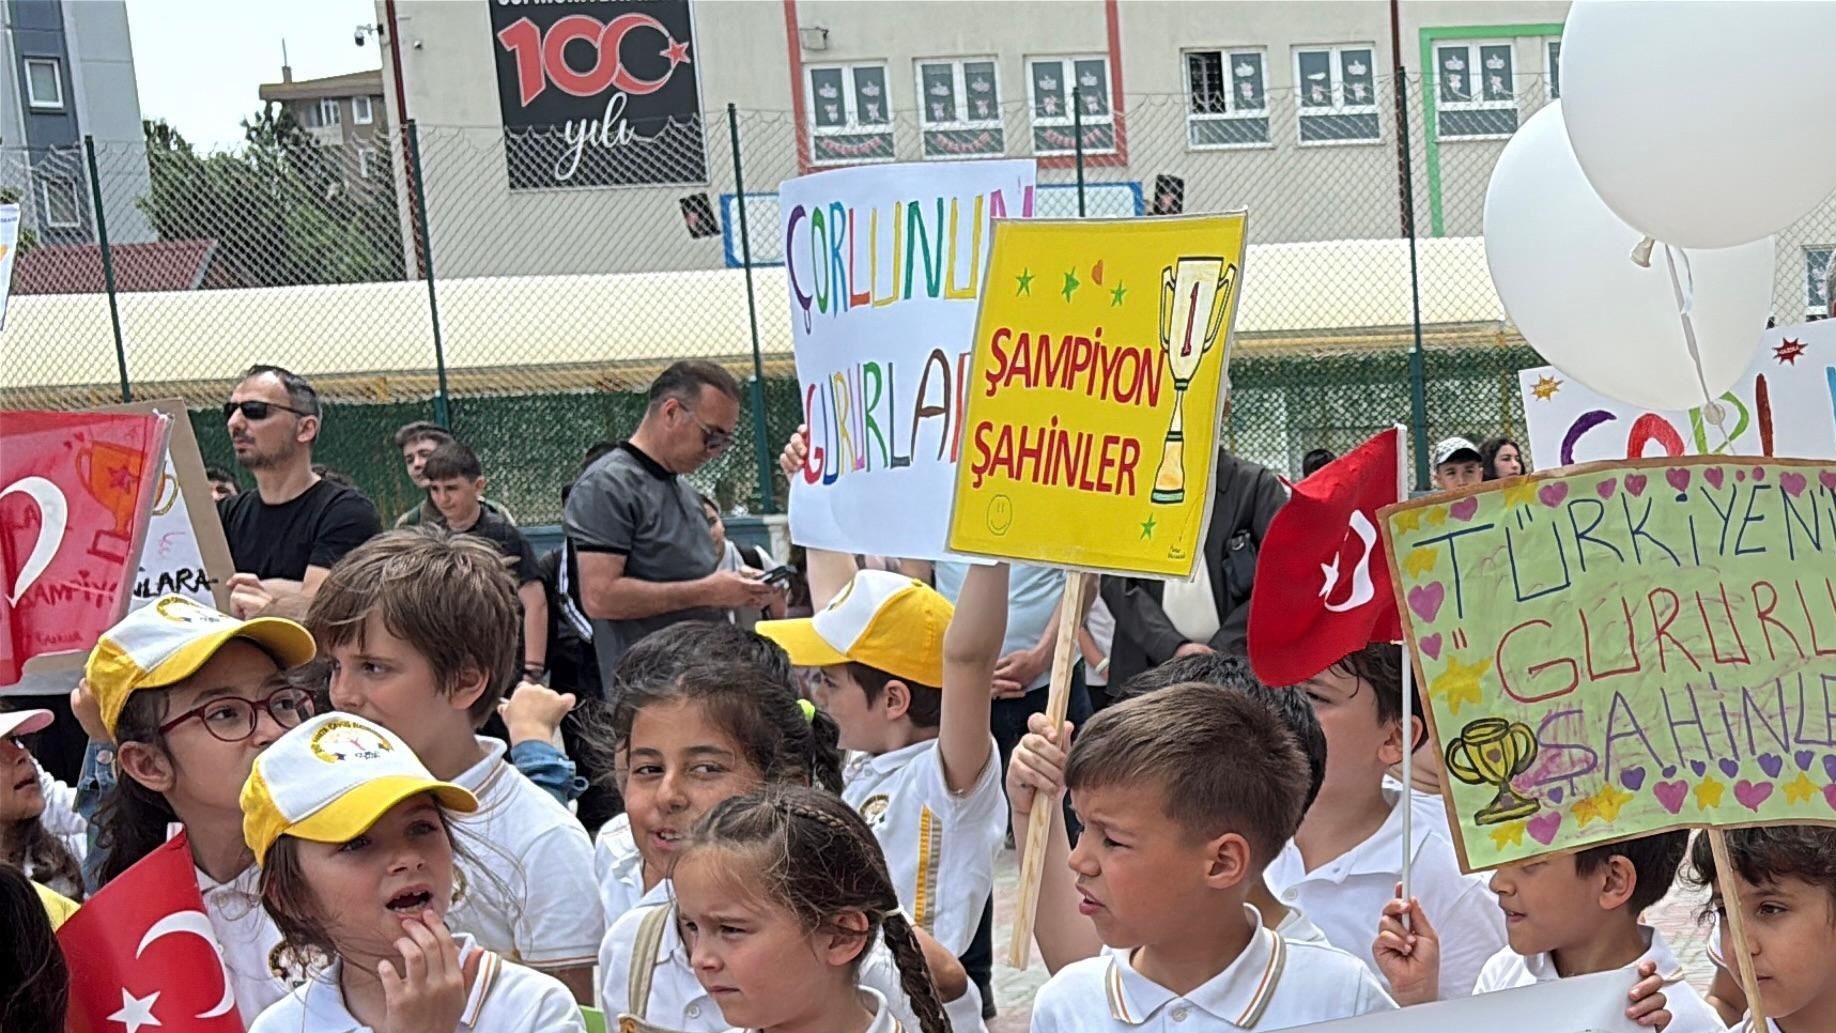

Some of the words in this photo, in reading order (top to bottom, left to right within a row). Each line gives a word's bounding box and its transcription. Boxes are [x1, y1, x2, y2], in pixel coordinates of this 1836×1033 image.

[555, 92, 635, 181] yılı
[985, 327, 1166, 407] ŞAMPİYON
[971, 414, 1141, 497] ŞAHİNLER
